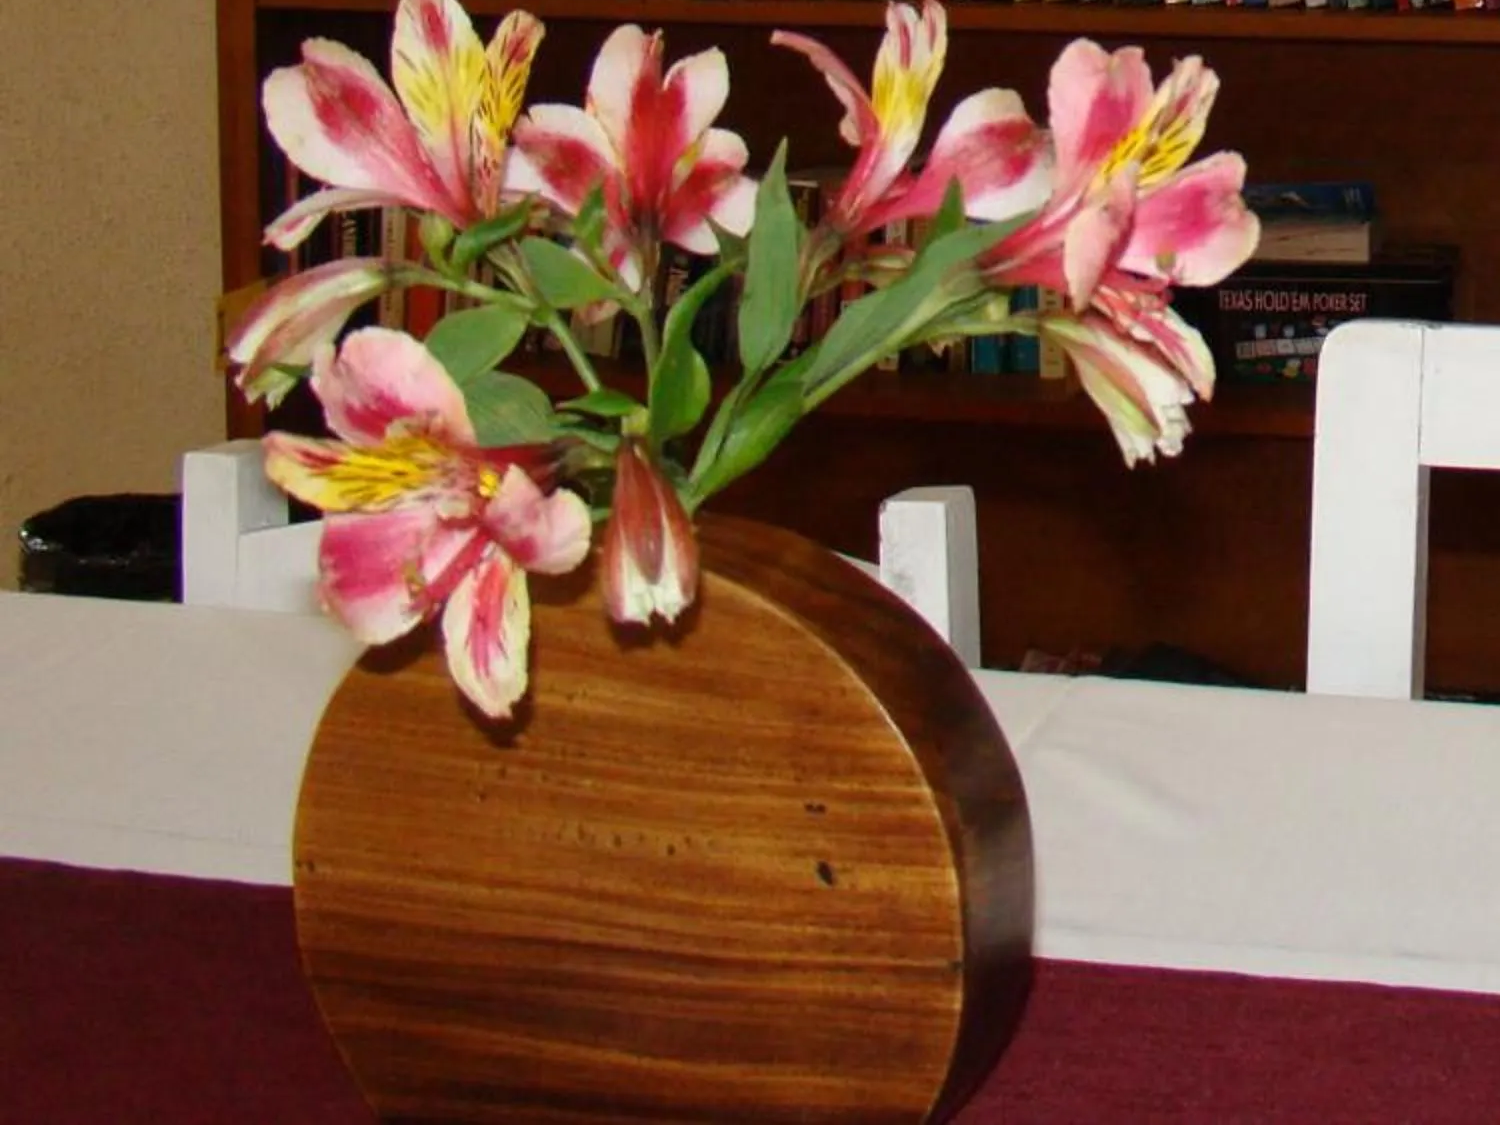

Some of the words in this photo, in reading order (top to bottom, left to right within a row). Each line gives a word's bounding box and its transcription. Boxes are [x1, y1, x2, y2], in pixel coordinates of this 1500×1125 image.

[1218, 290, 1253, 311] TEXAS
[1312, 292, 1347, 312] POKER
[1348, 292, 1368, 312] SET
